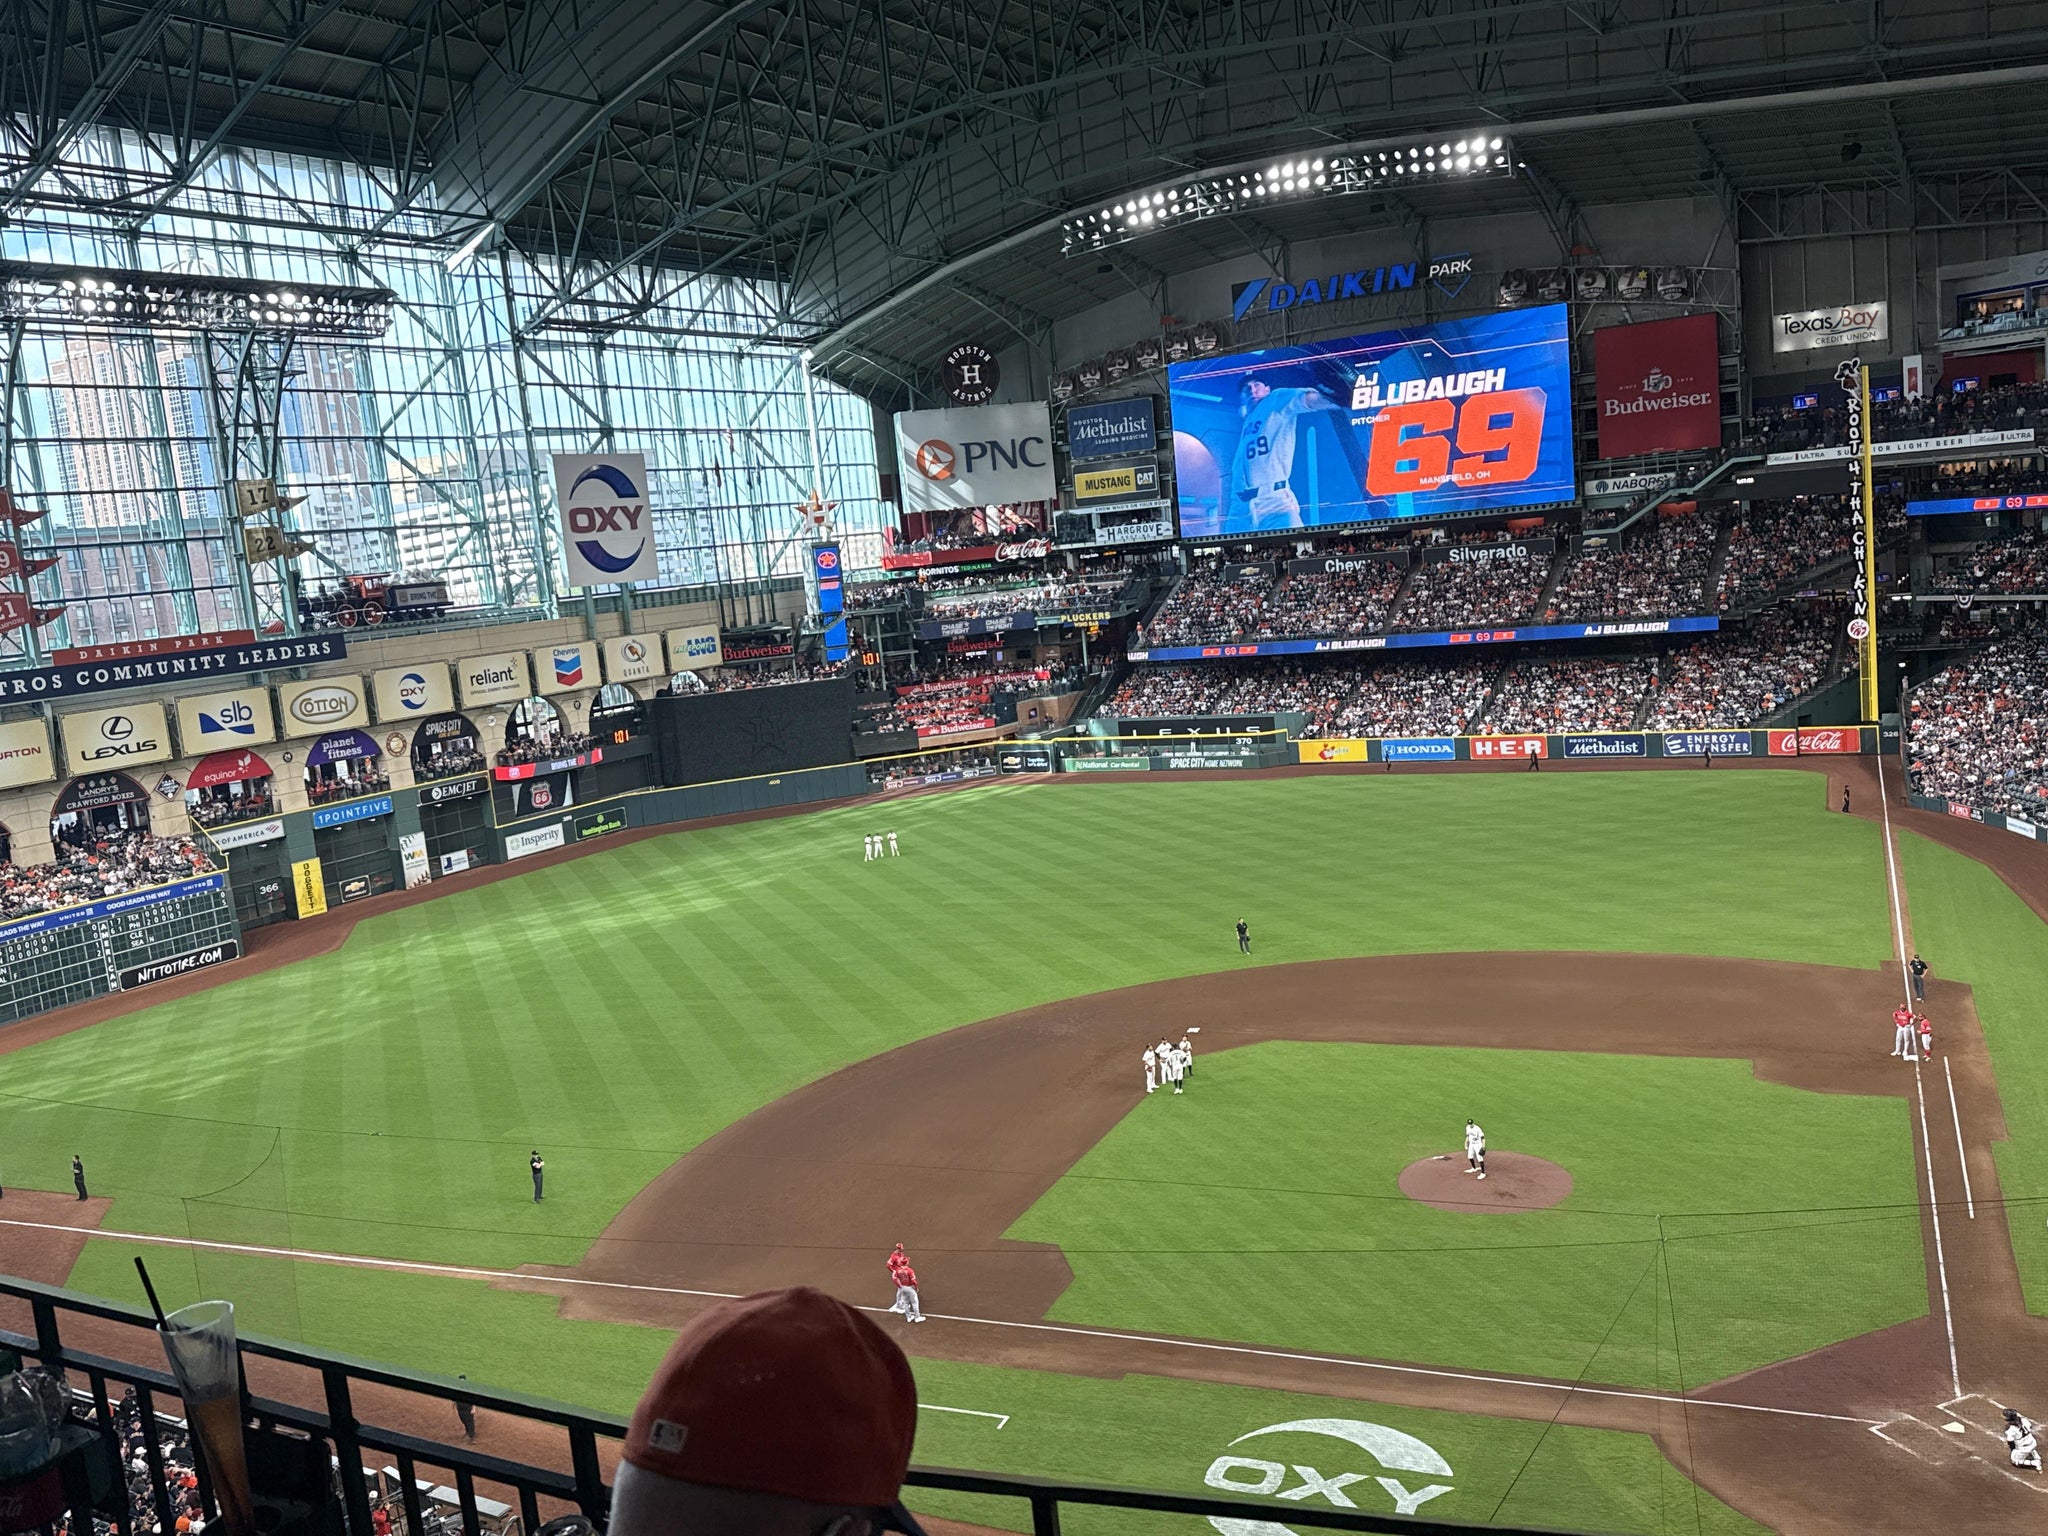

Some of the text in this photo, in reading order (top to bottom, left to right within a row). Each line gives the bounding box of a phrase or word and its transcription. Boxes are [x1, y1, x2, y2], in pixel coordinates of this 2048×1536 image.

[1268, 258, 1472, 312] DAIKIN PARK
[1780, 308, 1880, 335] Texas Bay
[1815, 331, 1876, 345] CREDIT UNION
[947, 346, 992, 364] HOUSTON
[960, 364, 982, 385] H
[1355, 372, 1379, 387] AJ
[952, 386, 992, 402] ASTROS
[1352, 368, 1506, 410] BLUBAUGH
[1604, 392, 1712, 416] Budweiser
[1073, 416, 1103, 426] HOUSTON
[1076, 415, 1147, 440] Methodist
[1352, 414, 1391, 426] PITCHER
[1846, 398, 1861, 455] ROOT
[1095, 433, 1148, 445] LEADING MEDICINE
[1365, 386, 1548, 497] 69
[2006, 431, 2032, 440] ULTRA
[1246, 435, 1270, 460] 69
[1897, 437, 1964, 450] LIGHT BEER
[959, 436, 1046, 473] PNC
[1800, 451, 1826, 460] ULTRA
[1848, 460, 1860, 476] 4
[1085, 472, 1154, 491] MUSTANG CAT
[1420, 470, 1491, 485] MANSFIELD, OH
[246, 488, 269, 505] 17
[1849, 481, 1864, 526] THA
[2006, 497, 2022, 508] 69
[568, 505, 644, 533] OXY
[1107, 523, 1163, 540] HARGROVE
[254, 536, 276, 552] 22
[1449, 543, 1527, 562] Silverado
[919, 565, 959, 576] HORNITOS
[1852, 531, 1867, 616] CHIKIN
[1060, 611, 1111, 622] PLUCKERS
[1584, 622, 1669, 636] AJ BLUBAUGH
[1315, 638, 1386, 650] AJ BLUBAUGH
[1476, 632, 1491, 642] 69
[79, 635, 224, 660] DAIKIN PARK
[552, 647, 580, 657] Chevron
[686, 636, 717, 657] LNG
[723, 644, 793, 661] Budweiser
[946, 638, 1005, 652] Budweiser
[1224, 646, 1237, 656] 69
[76, 653, 226, 687] COMMUNITY
[239, 641, 332, 665] LEADERS
[624, 666, 649, 677] QUANTA
[470, 667, 514, 687] reliant
[401, 686, 425, 696] OXY
[924, 681, 968, 692] Budweiser
[220, 700, 253, 724] slb
[300, 696, 348, 717] COTTON
[425, 720, 447, 736] SPACE
[447, 718, 462, 732] CITY
[940, 721, 986, 734] Budweiser
[322, 735, 355, 753] planet
[1686, 734, 1736, 744] ENERGY
[81, 739, 158, 761] LEXUS
[328, 746, 362, 760] fitness
[1394, 744, 1452, 754] HONDA
[1475, 740, 1542, 755] H-E-B
[1570, 740, 1639, 755] Methodist
[1687, 741, 1749, 754] TRANSFER
[1082, 761, 1108, 769] National
[1170, 757, 1243, 769] SPACE CITY HOME NETWORK
[204, 769, 237, 783] equinor
[78, 784, 119, 798] LANDRY'S
[442, 780, 477, 797] EMCJET
[66, 791, 135, 810] CRAWFORD BOXES
[535, 791, 547, 803] 66
[318, 800, 388, 825] 1POINTFIVE
[233, 830, 265, 843] AMERICA
[520, 828, 559, 846] Insperity
[404, 850, 424, 861] WM
[183, 882, 206, 892] UNITED
[259, 882, 279, 895] 366
[303, 863, 315, 909] DOGGETT
[106, 890, 171, 911] GOOD LEADS THE WAY
[59, 910, 86, 921] UNITED
[17, 924, 30, 933] THE
[30, 920, 46, 930] WAY
[129, 922, 141, 930] PHI
[130, 931, 143, 939] CLE
[131, 940, 144, 948] SEA
[101, 923, 118, 989] AMERICAN
[138, 947, 222, 984] NITTOTIRE.COM
[1203, 1456, 1455, 1516] OXY
